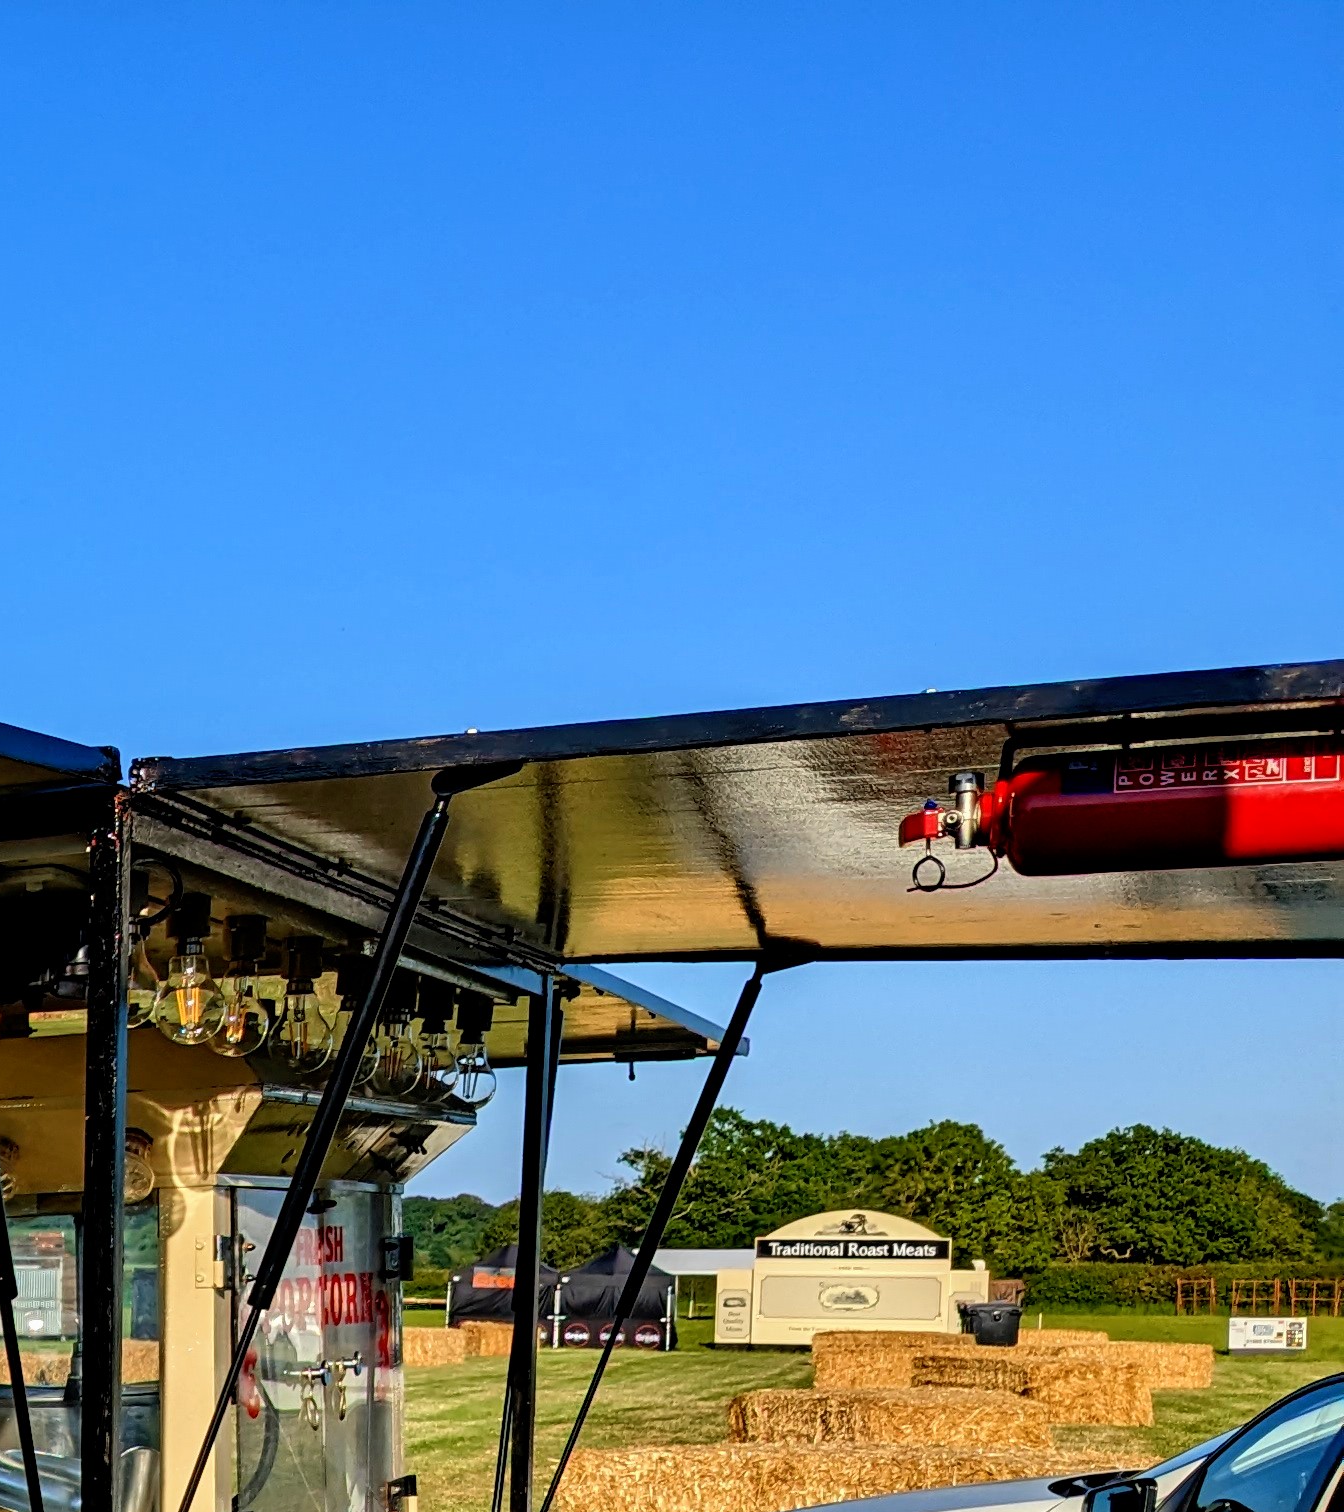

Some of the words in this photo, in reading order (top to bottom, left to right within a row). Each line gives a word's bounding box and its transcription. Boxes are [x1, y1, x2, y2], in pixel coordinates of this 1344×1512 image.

[295, 1226, 344, 1266] FRESH
[769, 1242, 845, 1257] Traditional
[848, 1242, 889, 1257] Roast
[893, 1242, 937, 1257] Meats
[276, 1273, 374, 1330] OPCORN
